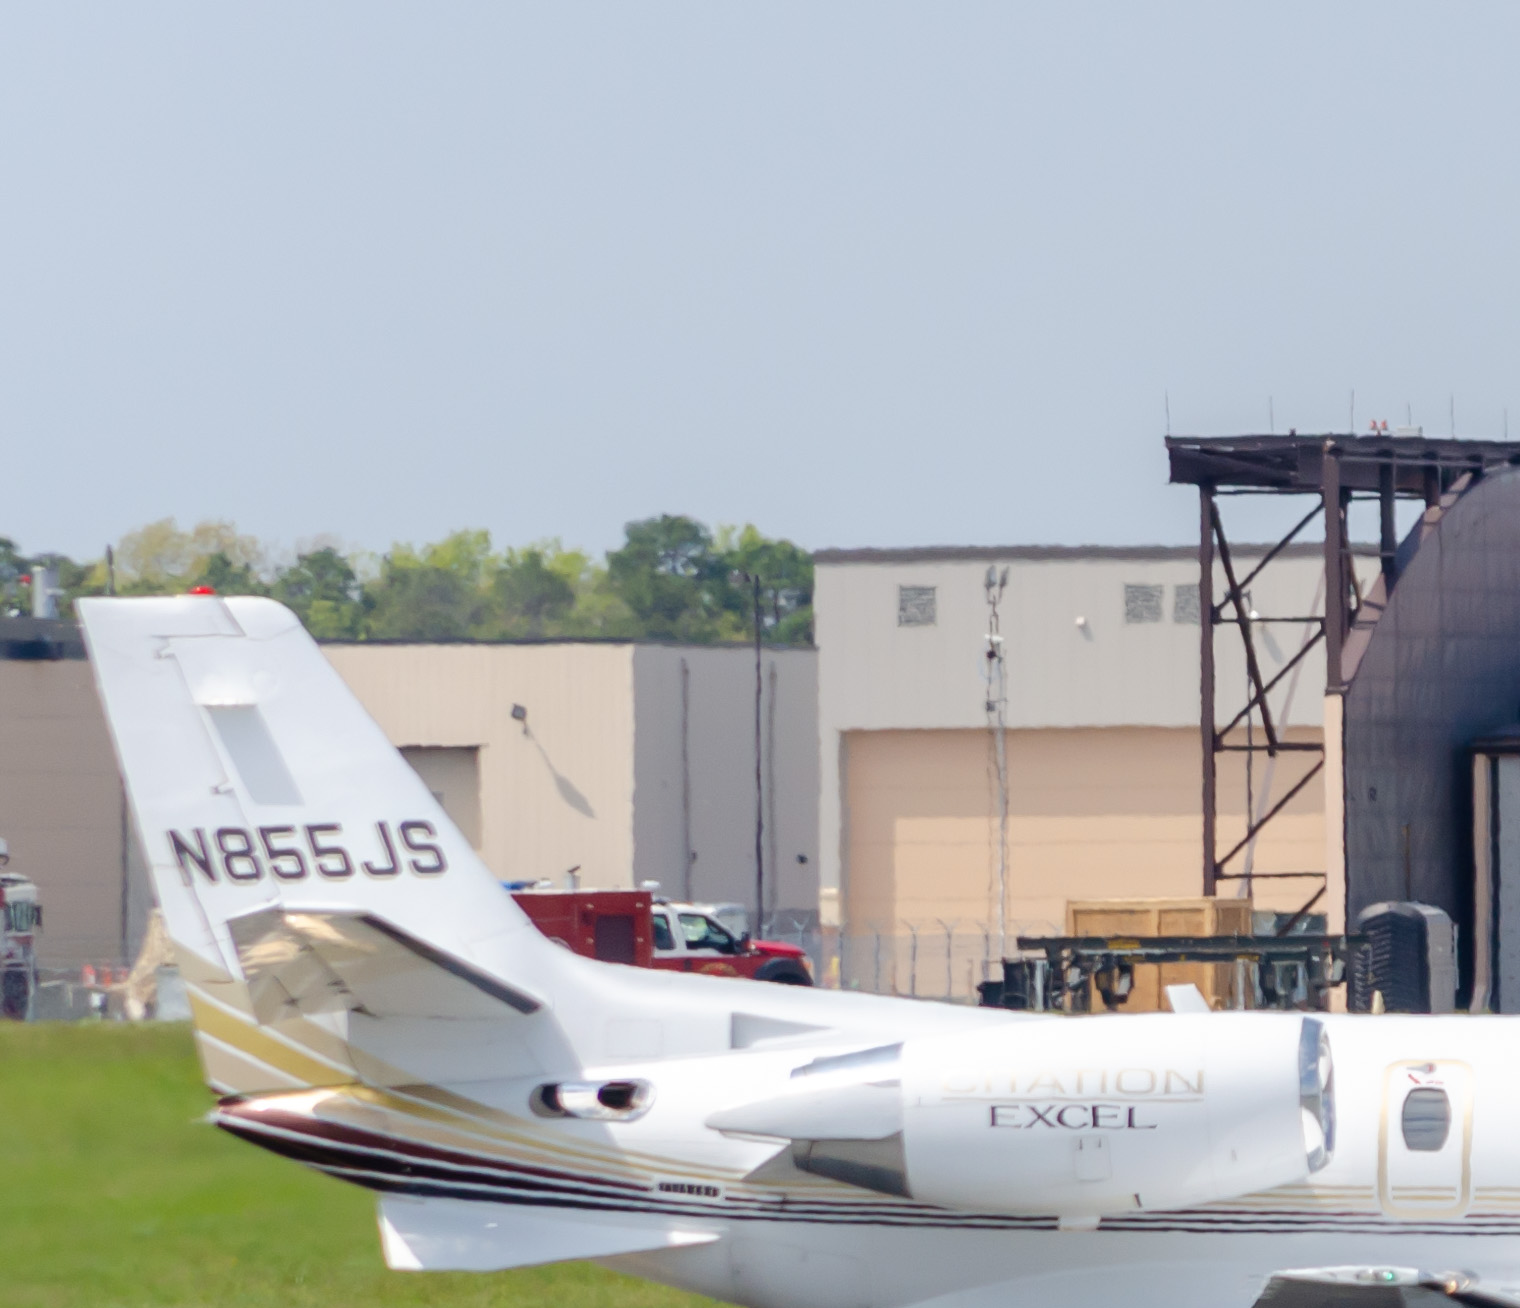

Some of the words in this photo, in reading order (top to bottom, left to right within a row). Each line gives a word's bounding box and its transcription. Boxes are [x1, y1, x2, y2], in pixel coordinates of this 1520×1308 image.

[167, 820, 447, 883] N855JS
[942, 1068, 1205, 1095] CITATION
[987, 1103, 1159, 1130] EXCEL
